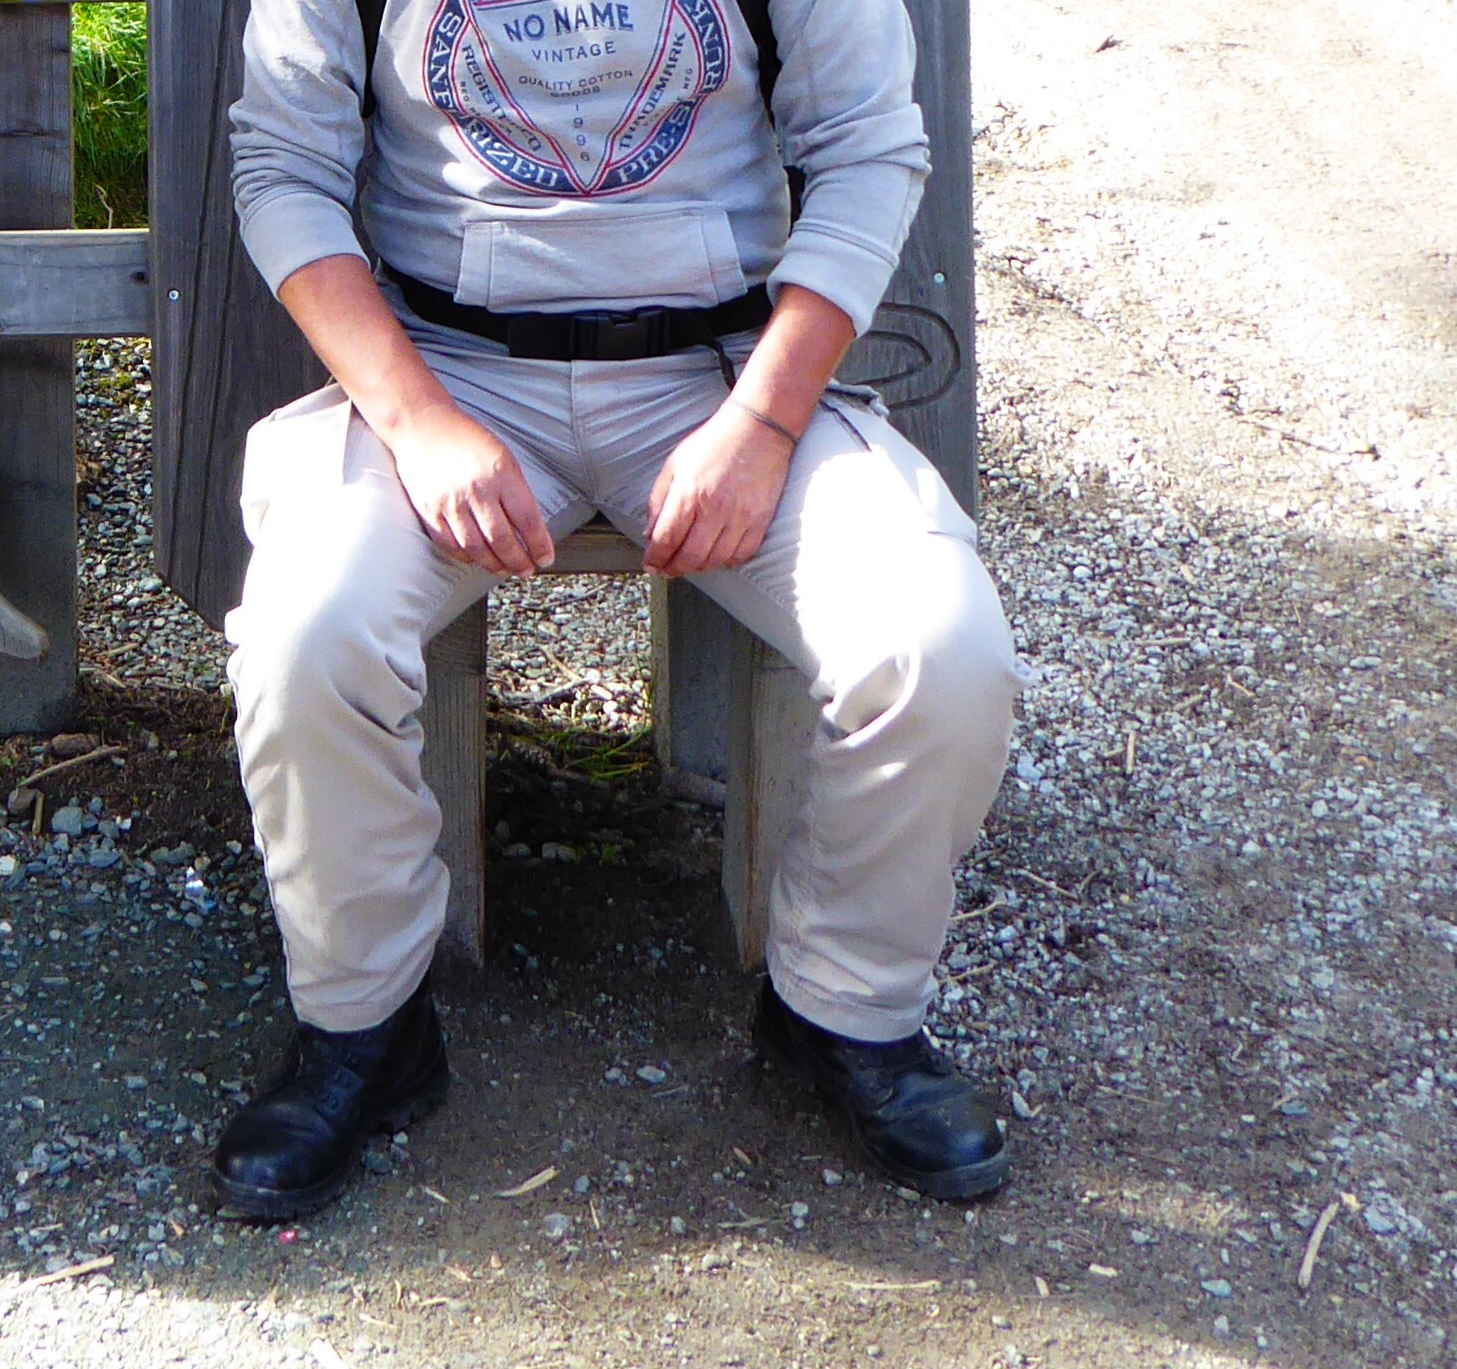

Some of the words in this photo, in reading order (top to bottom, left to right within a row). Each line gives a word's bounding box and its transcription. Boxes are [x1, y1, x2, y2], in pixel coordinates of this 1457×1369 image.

[503, 14, 545, 43] NO
[553, 2, 634, 35] NAME
[531, 41, 617, 63] VINTAGE
[429, 11, 558, 187] SANFRIZED
[462, 44, 542, 152] REGISTED
[518, 75, 573, 91] QUALITY
[578, 69, 634, 88] COTTON
